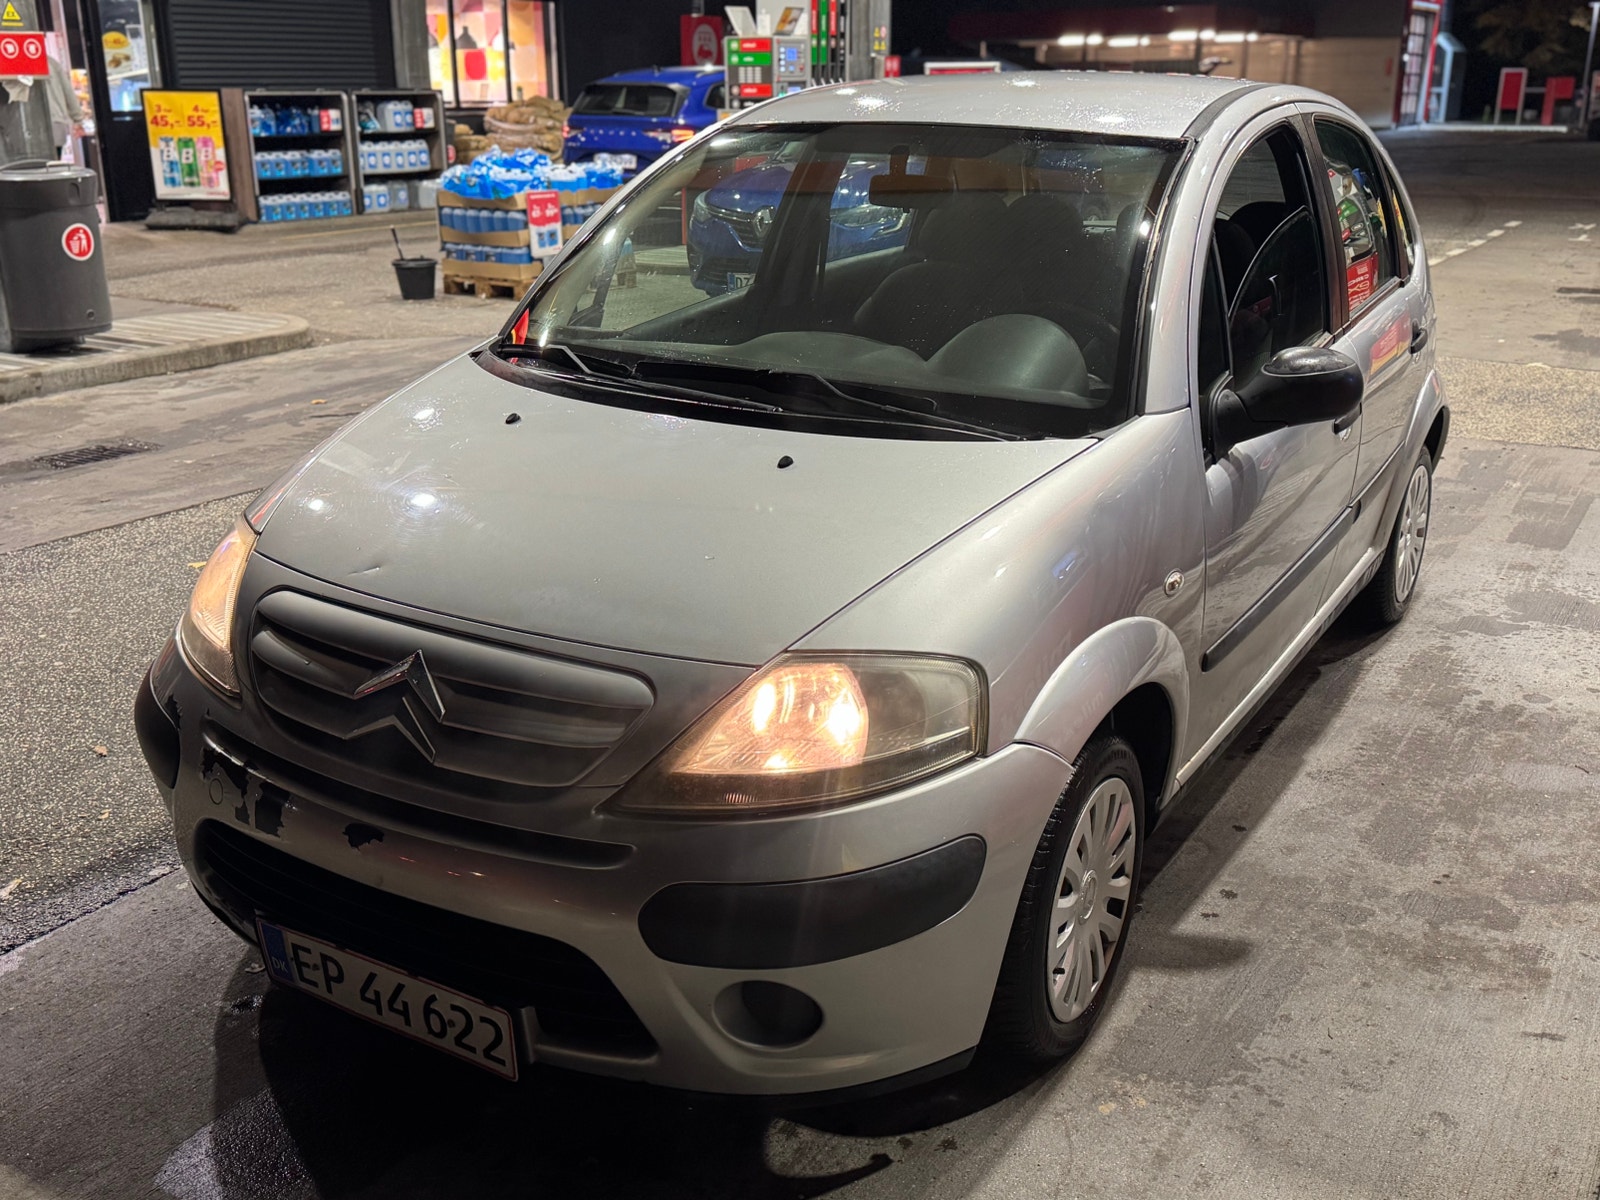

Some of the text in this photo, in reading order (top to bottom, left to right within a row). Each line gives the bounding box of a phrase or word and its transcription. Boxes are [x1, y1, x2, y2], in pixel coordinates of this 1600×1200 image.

[192, 104, 199, 112] 4
[151, 115, 181, 129] 45,-
[187, 115, 217, 130] 55,-
[182, 148, 193, 164] B
[271, 956, 289, 973] DK
[291, 943, 507, 1066] EP 44 622
